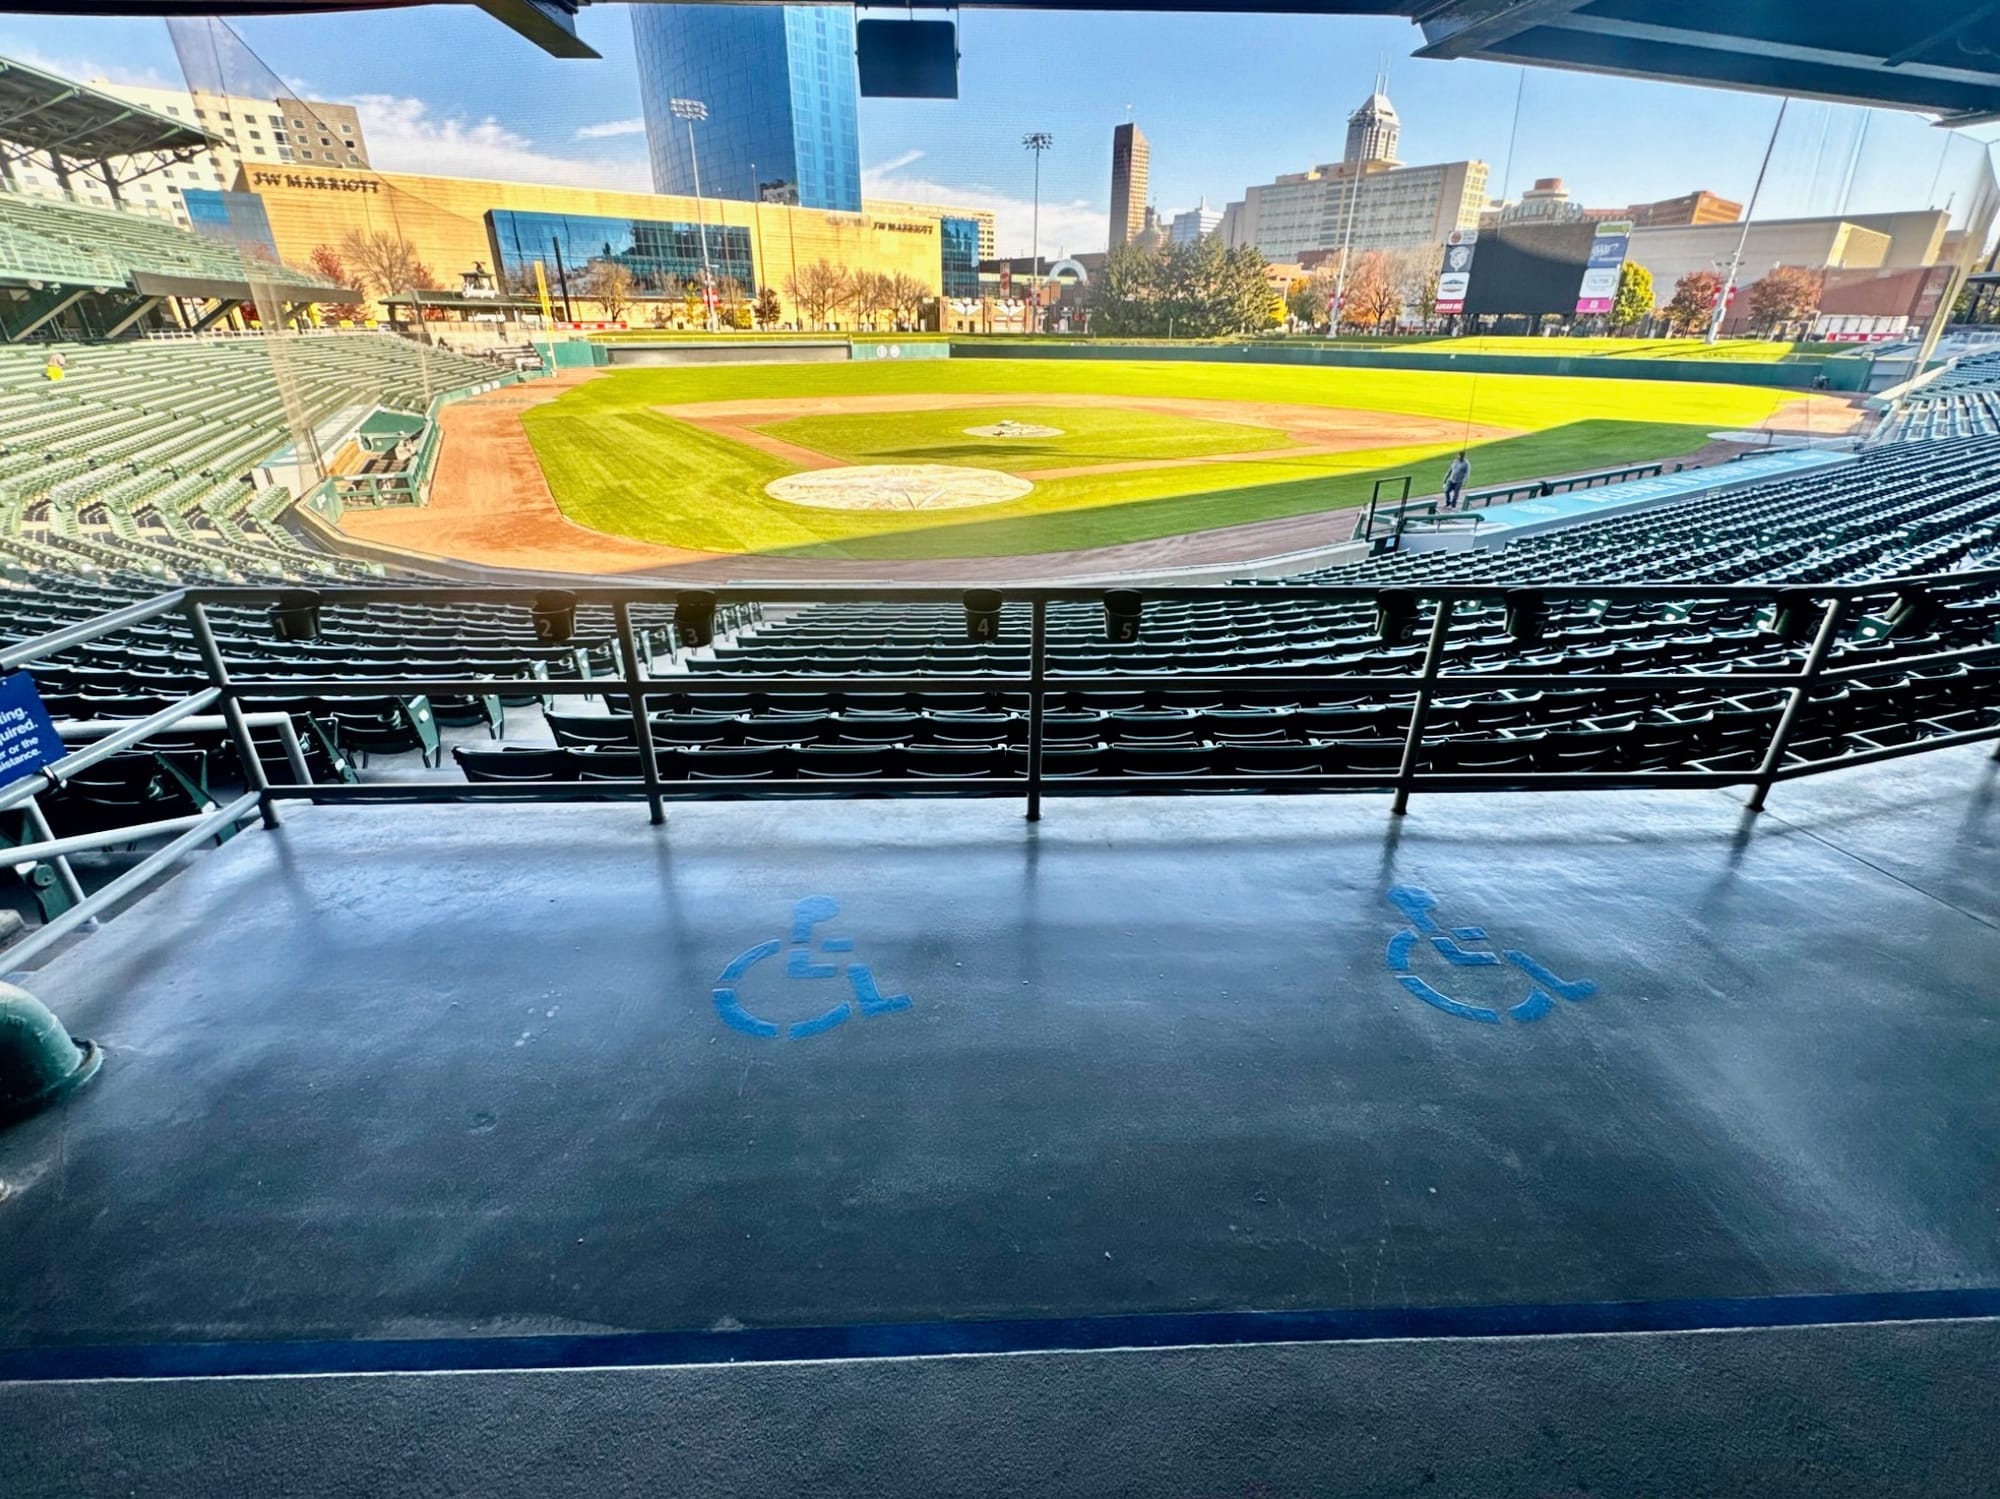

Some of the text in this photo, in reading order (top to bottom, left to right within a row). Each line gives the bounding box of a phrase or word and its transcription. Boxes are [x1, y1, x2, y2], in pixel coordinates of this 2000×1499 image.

[253, 172, 379, 194] JW MARRIOTT
[872, 221, 933, 235] JW MARRIOTT
[275, 617, 288, 637] 1
[539, 619, 553, 637] 2
[978, 618, 990, 636] 4
[1120, 622, 1133, 640] 5
[1400, 624, 1413, 641] 6
[685, 628, 699, 645] 3
[0, 718, 39, 746] uired.
[8, 744, 20, 755] or
[21, 737, 39, 749] the
